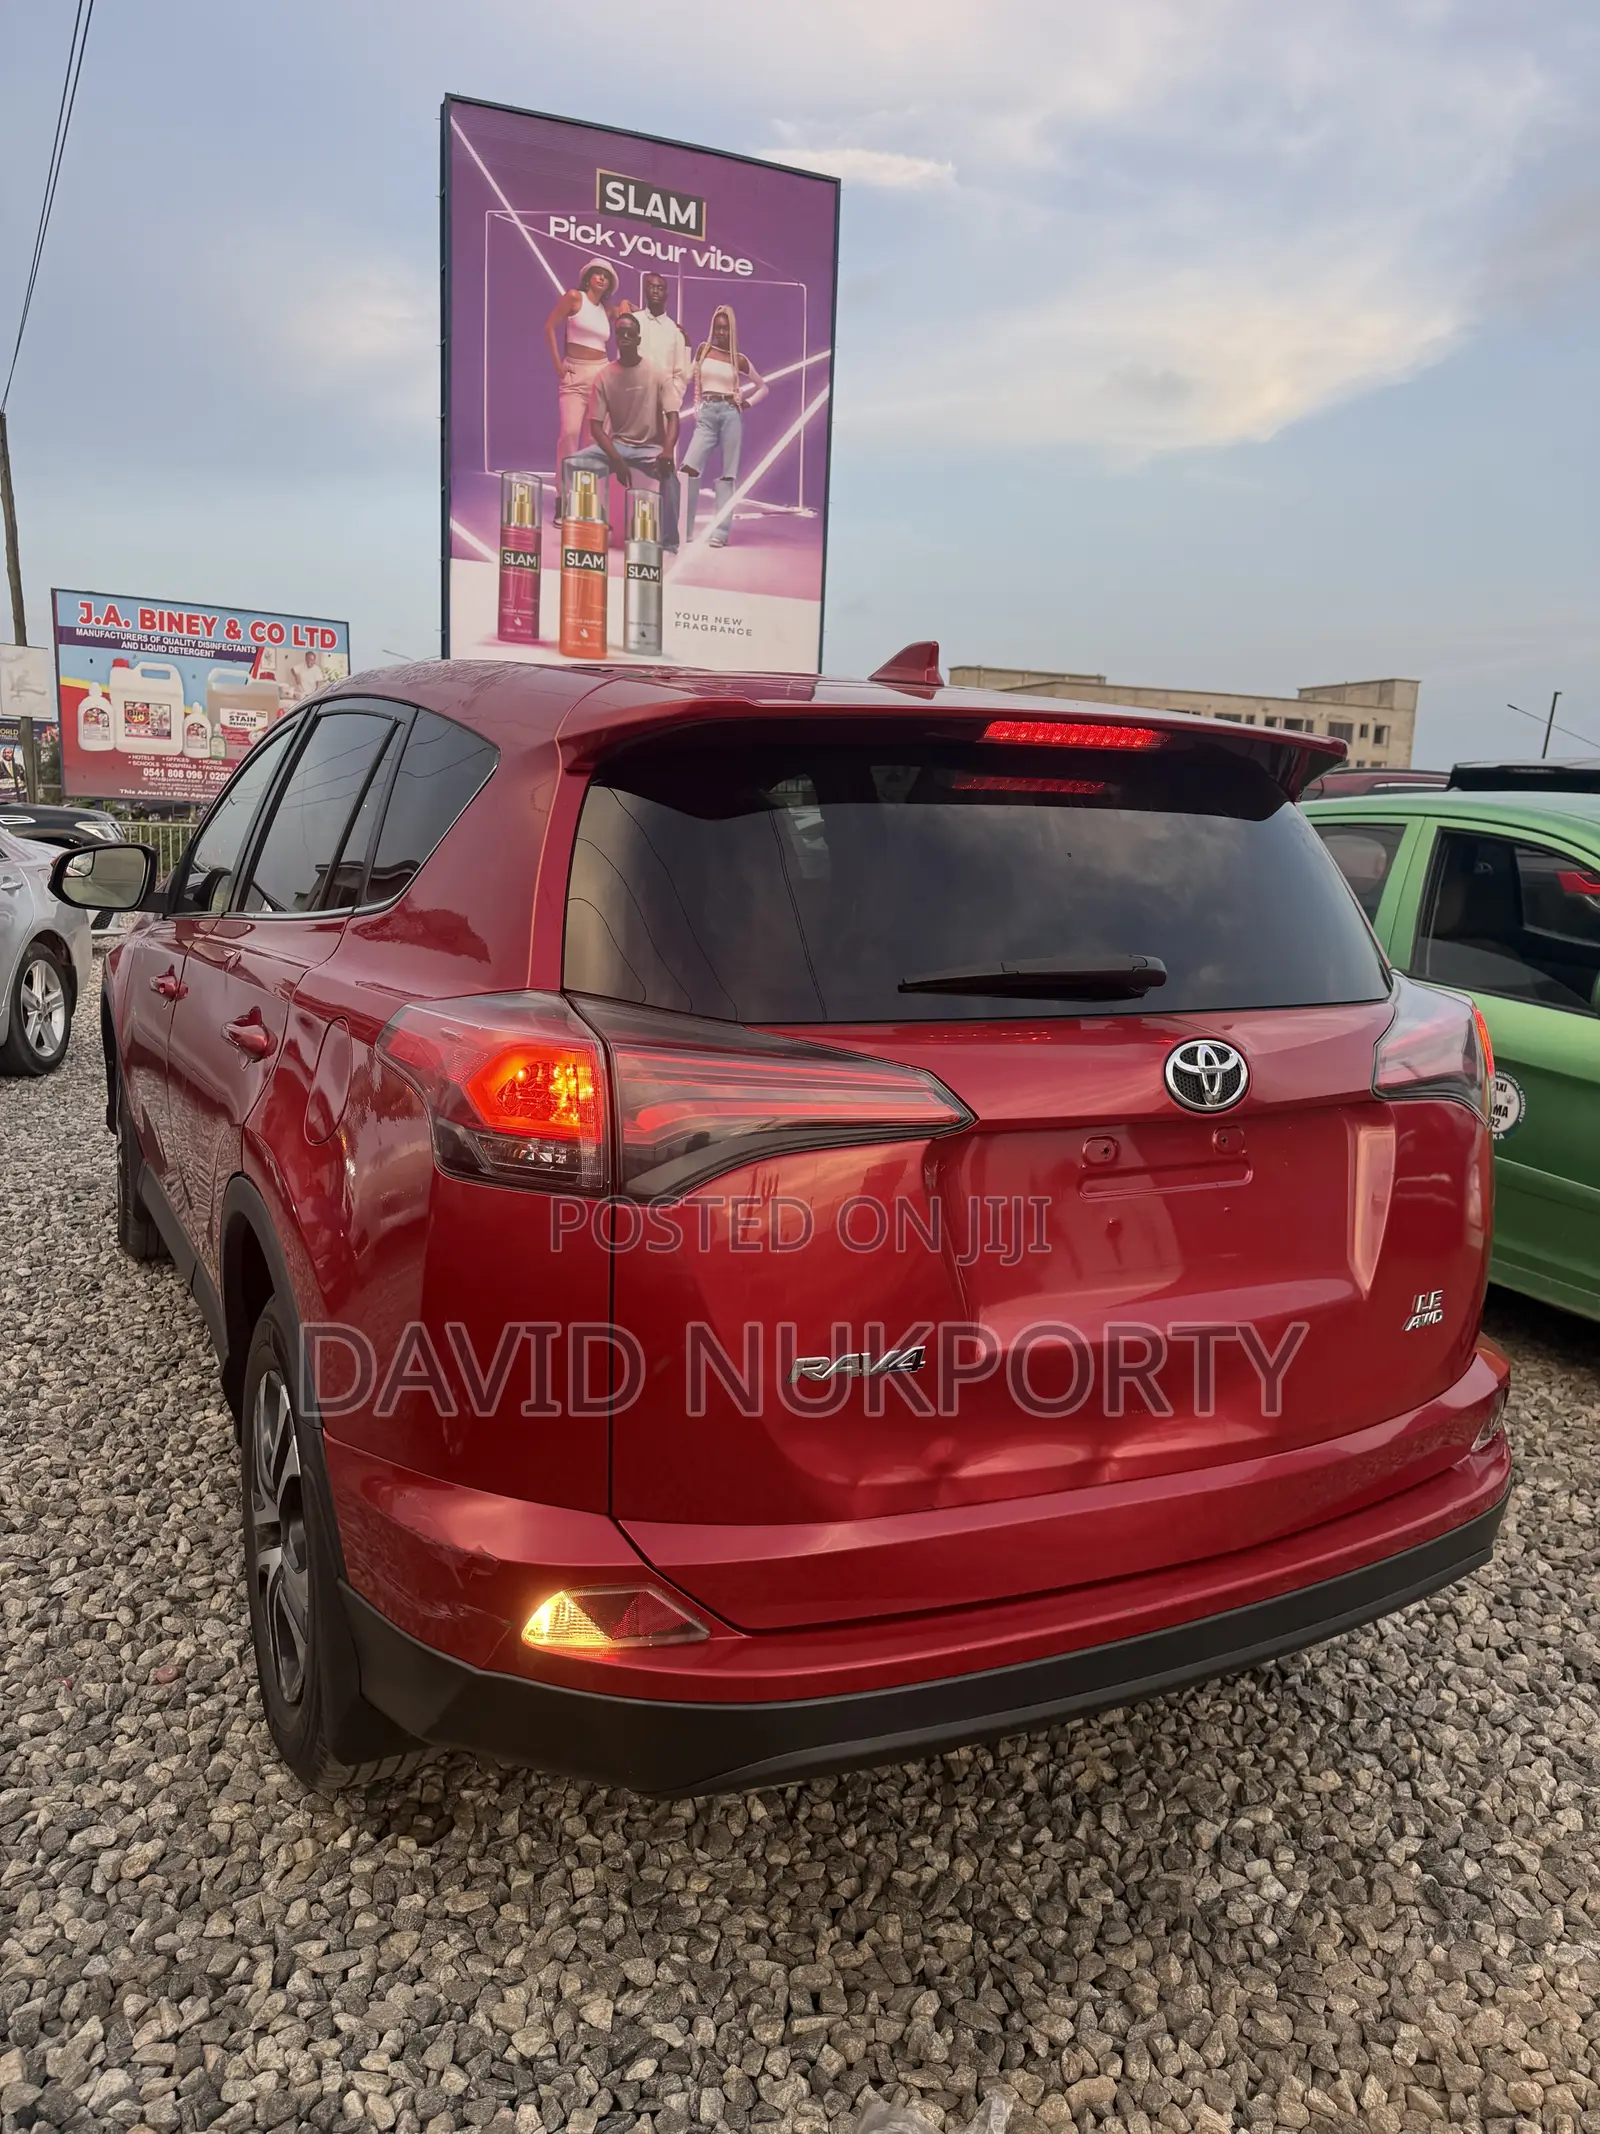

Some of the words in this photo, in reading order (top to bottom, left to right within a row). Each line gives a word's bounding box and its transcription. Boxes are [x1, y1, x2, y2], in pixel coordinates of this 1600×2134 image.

[605, 181, 696, 230] SLAM
[549, 215, 616, 249] Pick
[619, 231, 687, 263] your
[692, 245, 754, 276] vibe
[503, 552, 537, 567] SLAM
[566, 551, 604, 570] SLAM
[628, 565, 660, 581] SLAM
[79, 601, 132, 629] J.A.
[138, 607, 219, 638] BINEY
[224, 617, 243, 642] &
[249, 620, 286, 645] CO
[292, 624, 338, 650] LTD
[675, 611, 709, 622] YOUR
[714, 616, 742, 626] NEW
[674, 620, 753, 637] FRAGRANCE
[75, 628, 149, 643] MANUFACTURERS
[150, 635, 161, 644] OF
[162, 636, 197, 648] QUALITY
[197, 641, 257, 654] DISINFECTANTS
[121, 641, 139, 650] AND
[140, 643, 167, 653] LIQUID
[168, 645, 216, 658] DETERGENT
[229, 715, 257, 723] STAIN
[0, 728, 19, 736] ORLD
[132, 760, 160, 768] SCHOOLS
[166, 762, 197, 770] HOSPITALS
[143, 767, 165, 778] 0541
[137, 789, 163, 797] Advert
[190, 792, 217, 800] Approv
[1412, 1289, 1444, 1314] LE
[1403, 1309, 1444, 1332] AWD
[787, 1345, 927, 1384] RAV4
